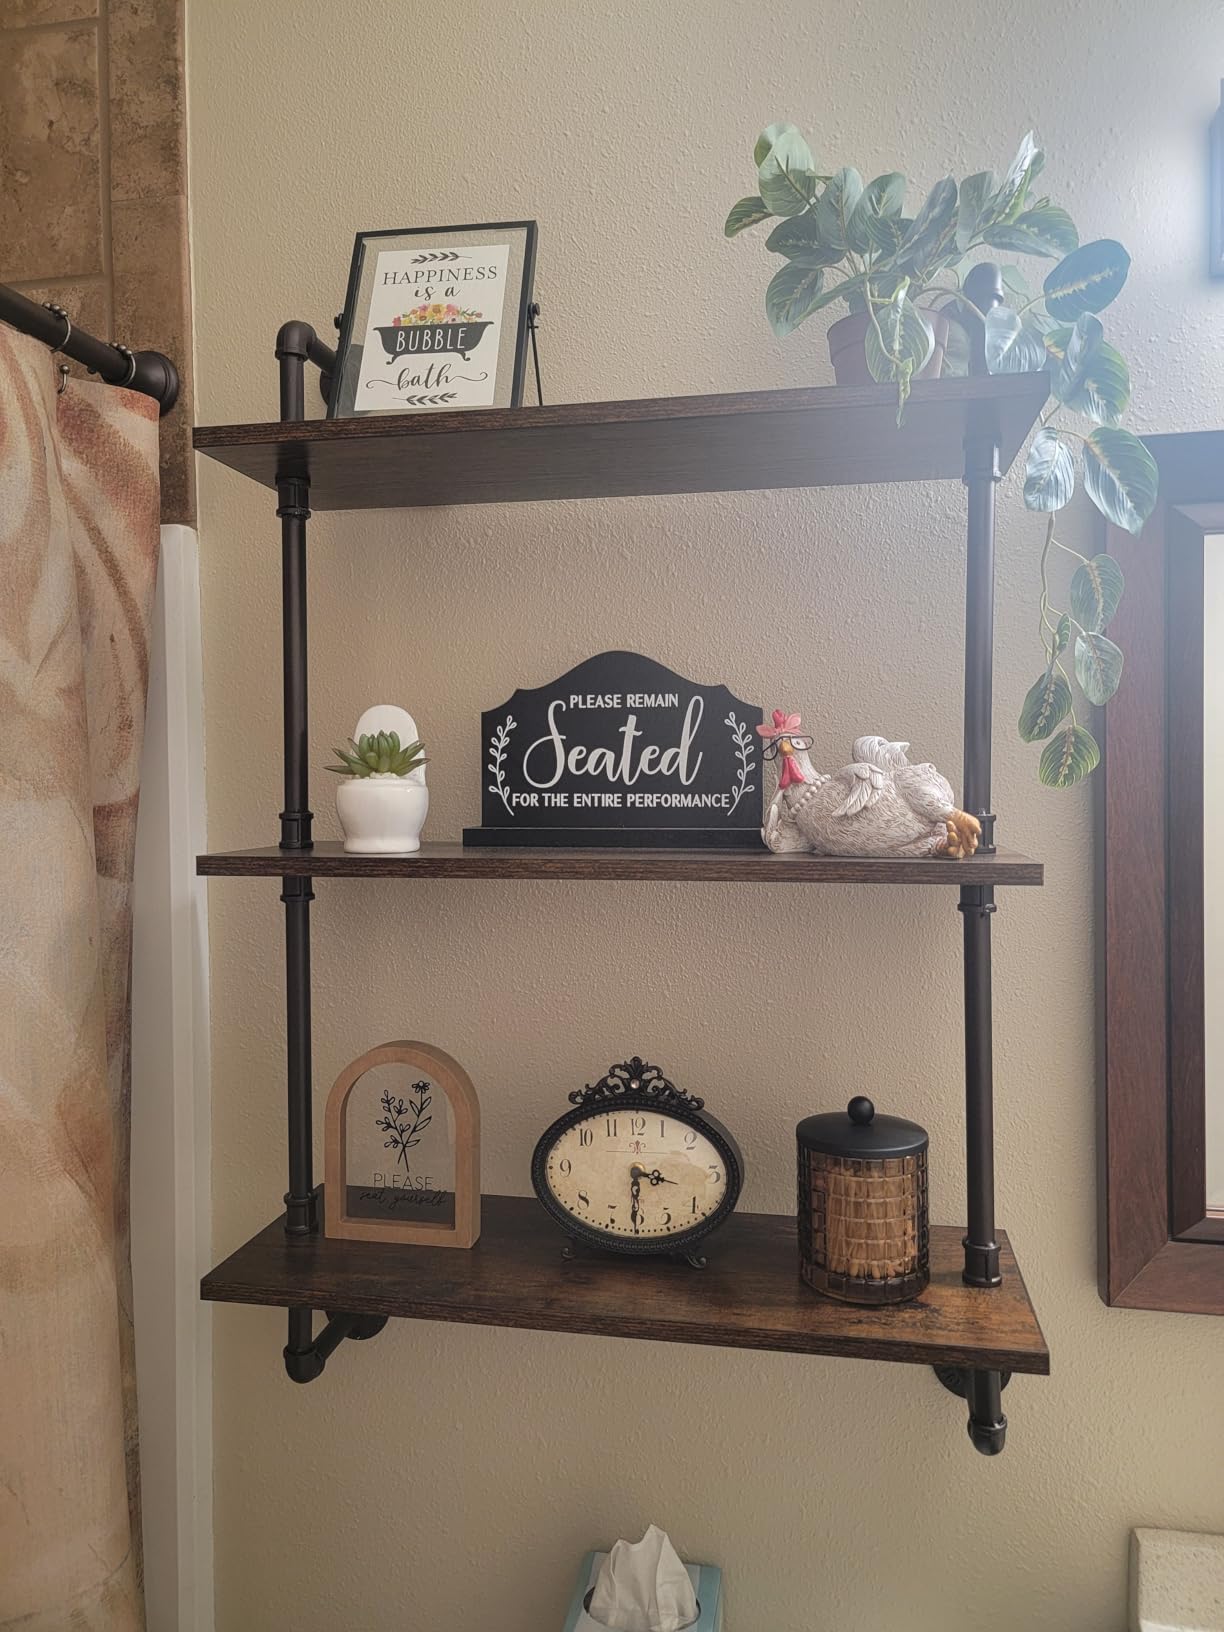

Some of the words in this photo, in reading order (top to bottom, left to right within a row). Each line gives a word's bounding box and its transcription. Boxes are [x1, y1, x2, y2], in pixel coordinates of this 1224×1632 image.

[383, 266, 497, 285] HAPPINESS
[414, 286, 436, 301] is
[444, 285, 461, 298] a
[396, 328, 467, 352] BUBBLE
[569, 693, 622, 709] PLEASE
[626, 693, 679, 708] REMAIN
[523, 695, 704, 789] Seated
[511, 793, 539, 807] FOR
[542, 793, 569, 807] THE
[573, 793, 622, 808] ENTIRE
[626, 793, 730, 808] PERFORMANCE
[606, 1118, 618, 1137] 11
[630, 1117, 646, 1136] 12
[660, 1119, 665, 1138] 1
[579, 1128, 593, 1147] 10
[684, 1132, 698, 1150] 2
[559, 1158, 572, 1177] 9
[705, 1165, 721, 1184] 3
[373, 1172, 434, 1191] PLEASE
[577, 1190, 590, 1210] 8
[660, 1207, 672, 1225] 5
